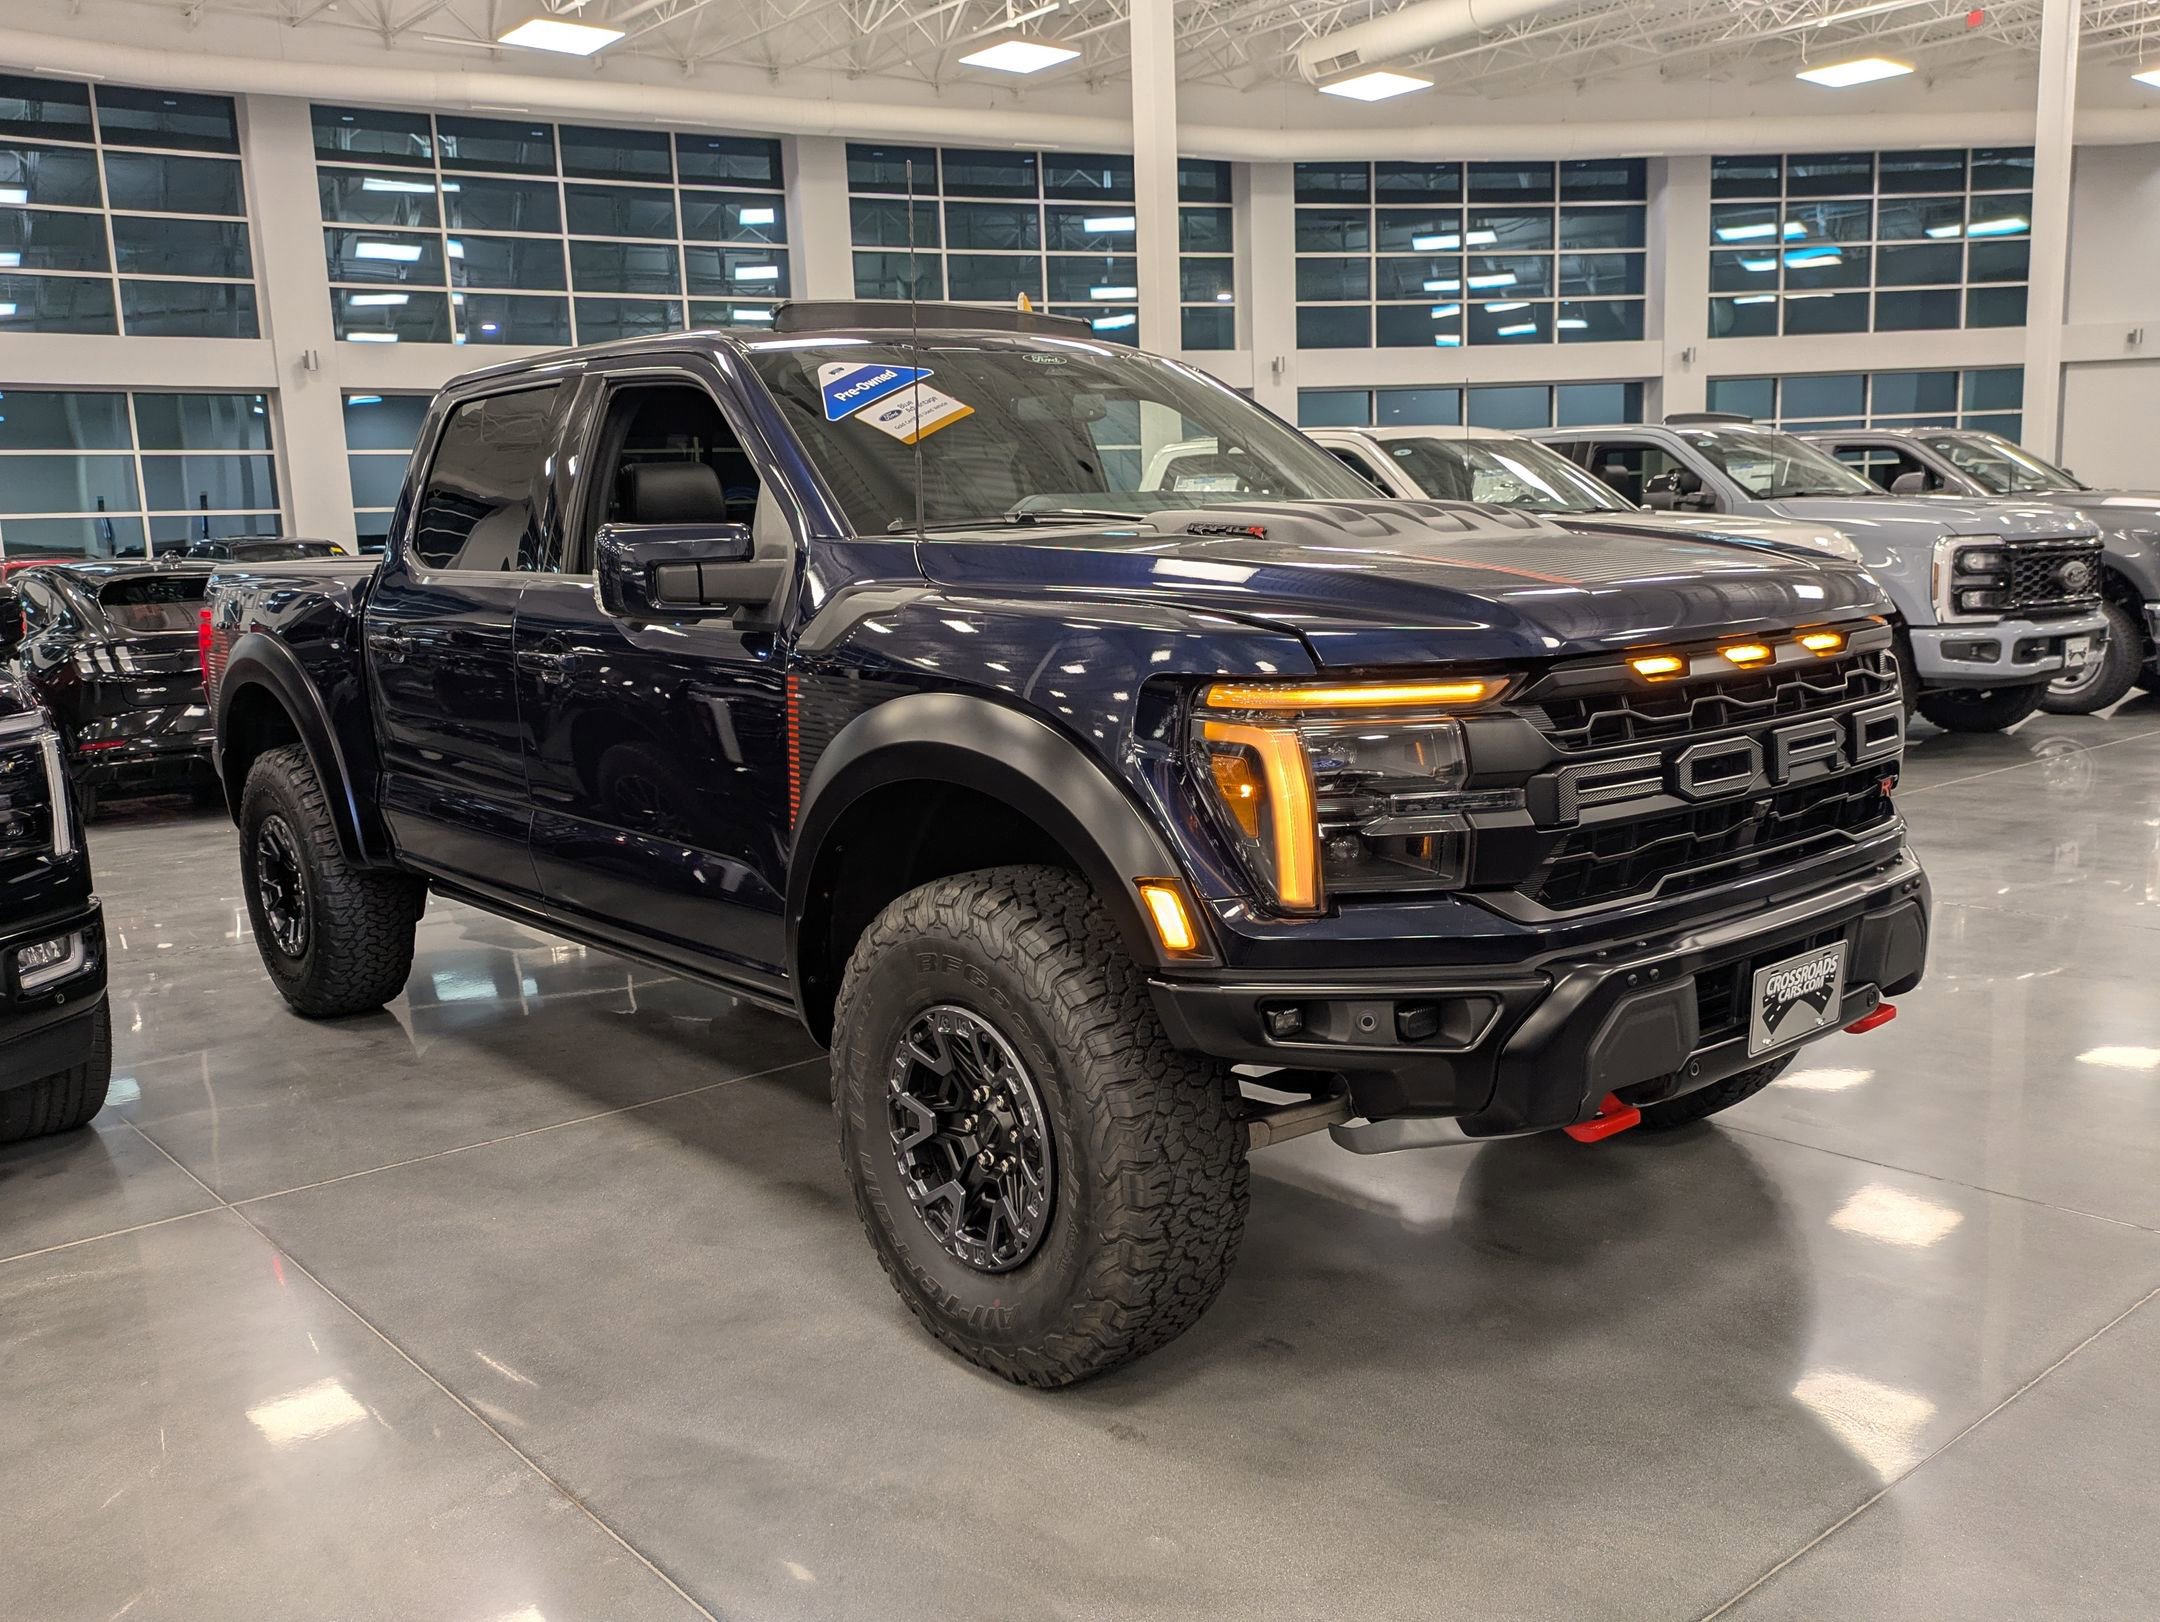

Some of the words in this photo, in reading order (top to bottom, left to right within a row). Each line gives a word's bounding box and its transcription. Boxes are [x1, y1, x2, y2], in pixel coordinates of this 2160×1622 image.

[833, 369, 898, 401] Pre-Owned
[905, 396, 938, 413] Adntage
[1555, 701, 1903, 824] FORD
[1766, 954, 1839, 995] CROSSROADS
[1778, 975, 1825, 1003] CARS.COM
